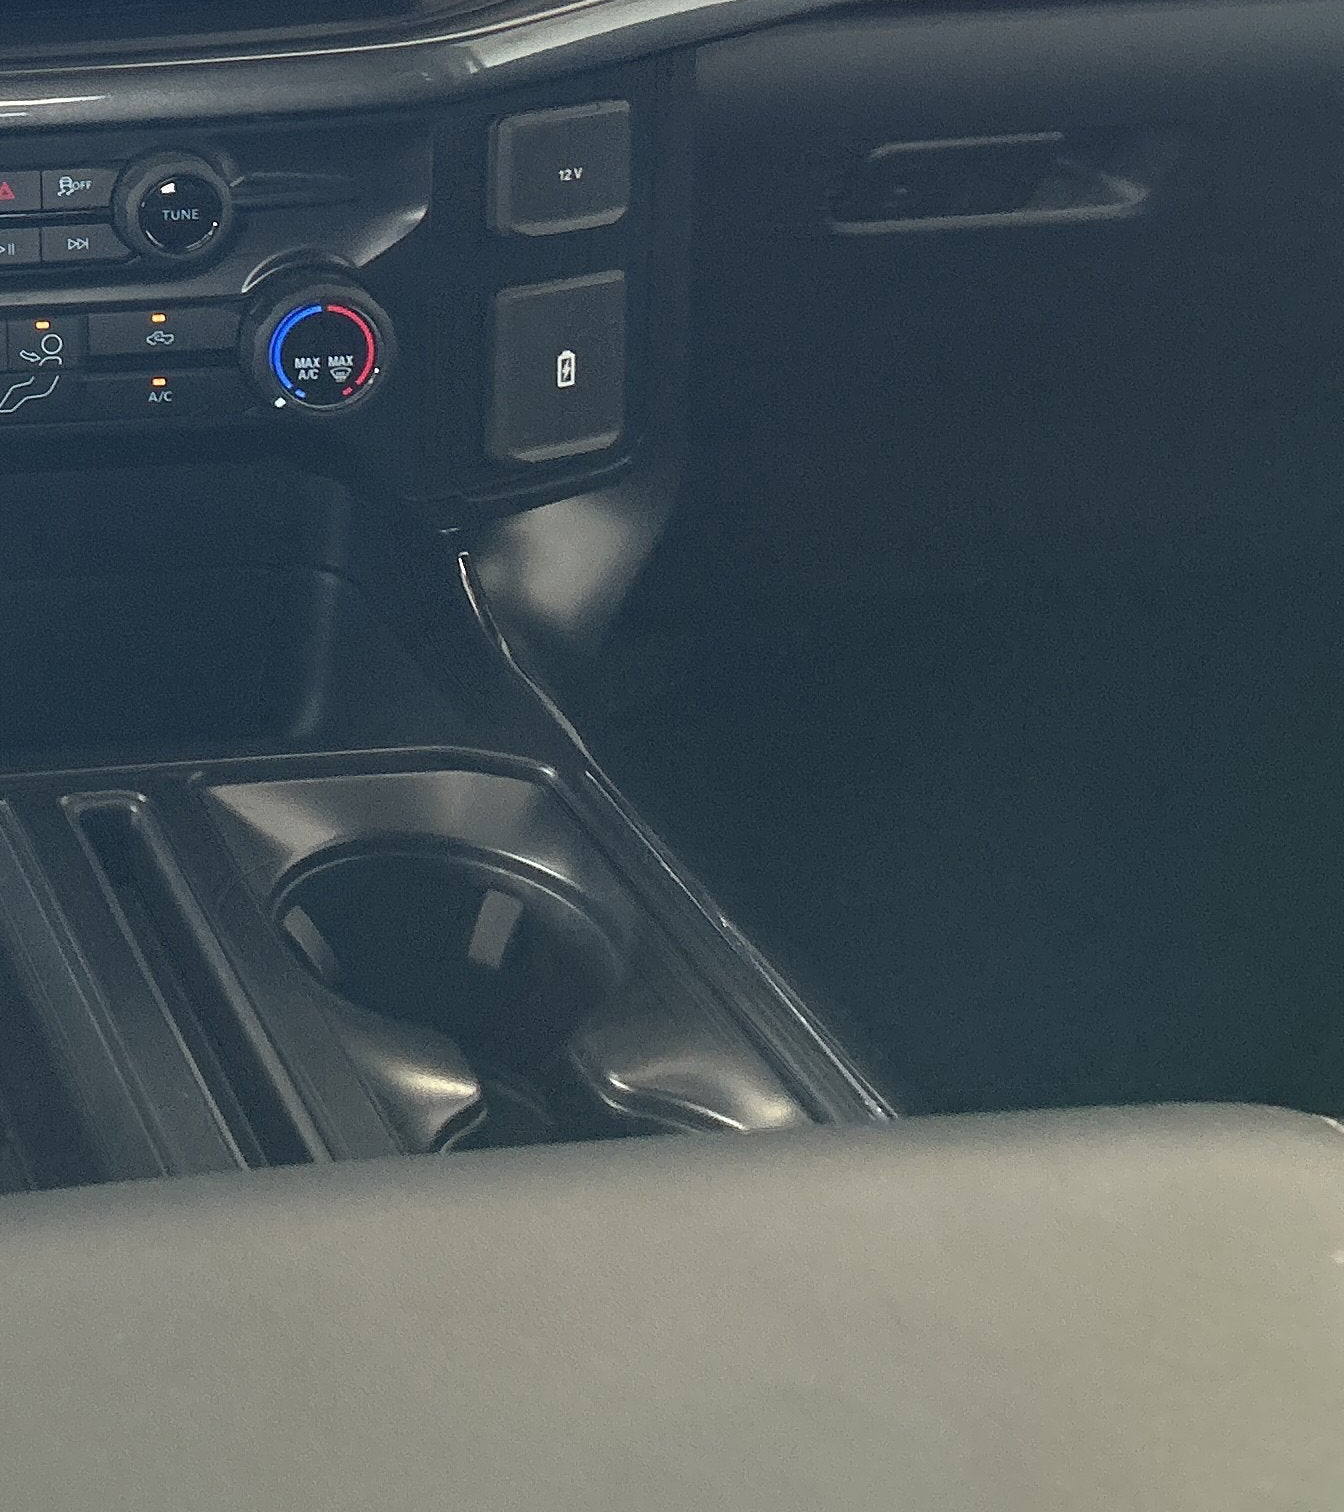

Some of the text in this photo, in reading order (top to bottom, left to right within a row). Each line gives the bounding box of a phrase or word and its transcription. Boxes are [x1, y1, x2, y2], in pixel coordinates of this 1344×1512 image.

[72, 178, 92, 191] OFF
[162, 208, 200, 221] TUNE
[294, 356, 321, 369] MAX
[327, 354, 353, 367] MAX
[298, 369, 319, 380] A/C
[148, 391, 173, 403] A/C
